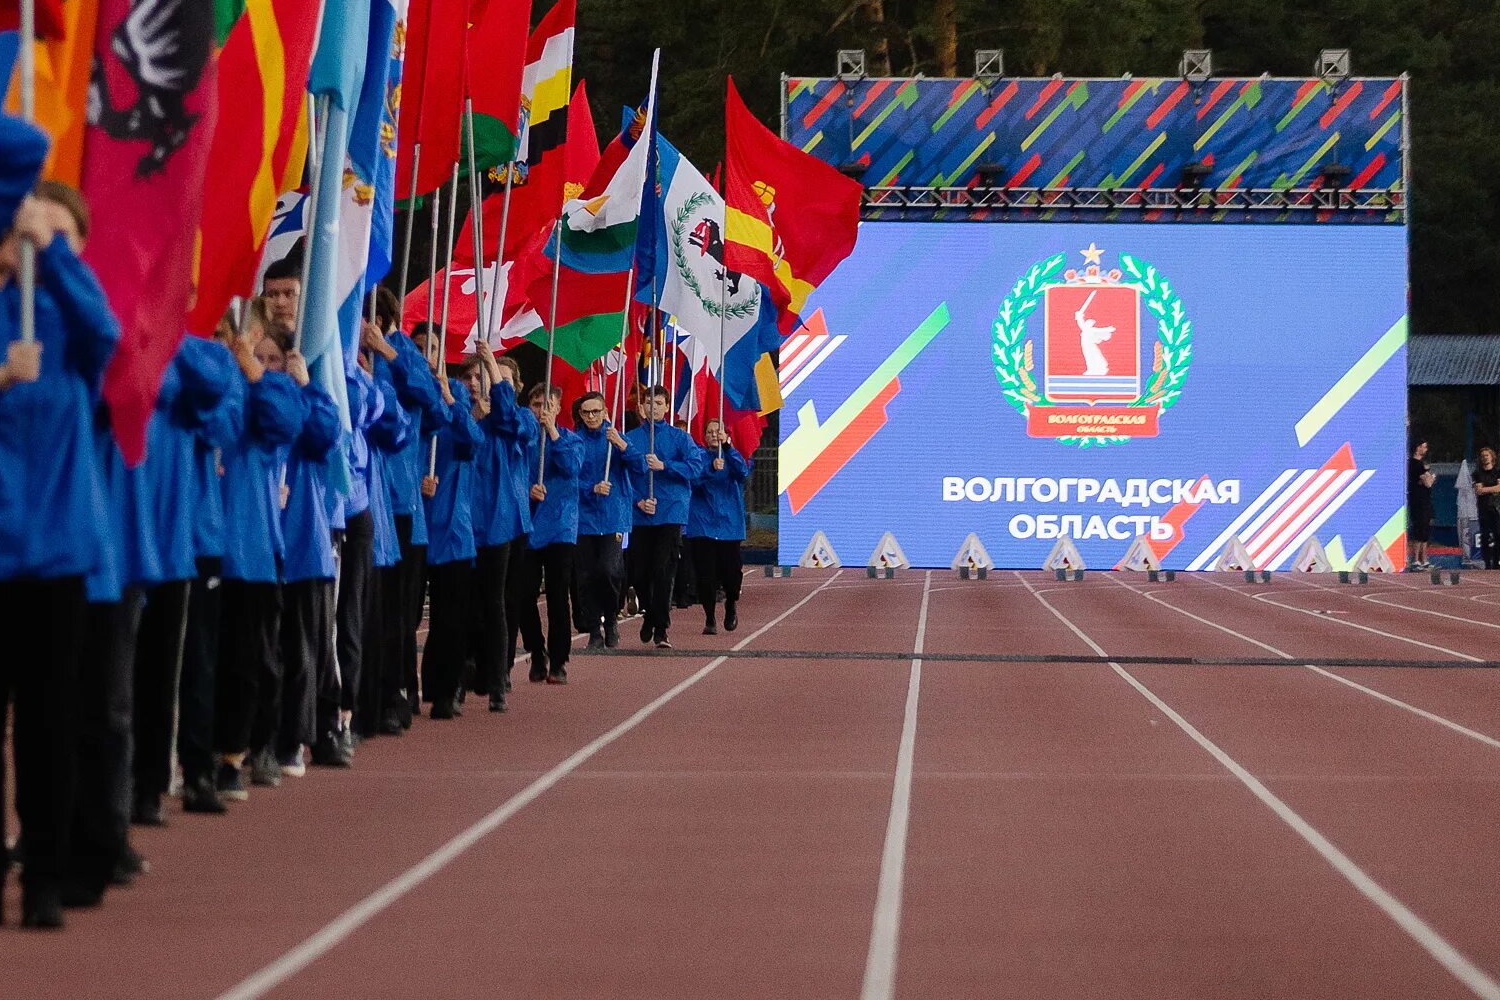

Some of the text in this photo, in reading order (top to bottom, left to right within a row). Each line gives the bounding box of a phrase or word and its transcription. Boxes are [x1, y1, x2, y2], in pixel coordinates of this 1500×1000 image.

[1047, 415, 1146, 425] ВОЛГОГРАДСКАЯ
[1076, 425, 1117, 433] ОБЛАСТЬ
[942, 476, 1240, 507] ВОЛГОГРАДСКАЯ
[1008, 514, 1174, 540] ОБЛАСТЬ
